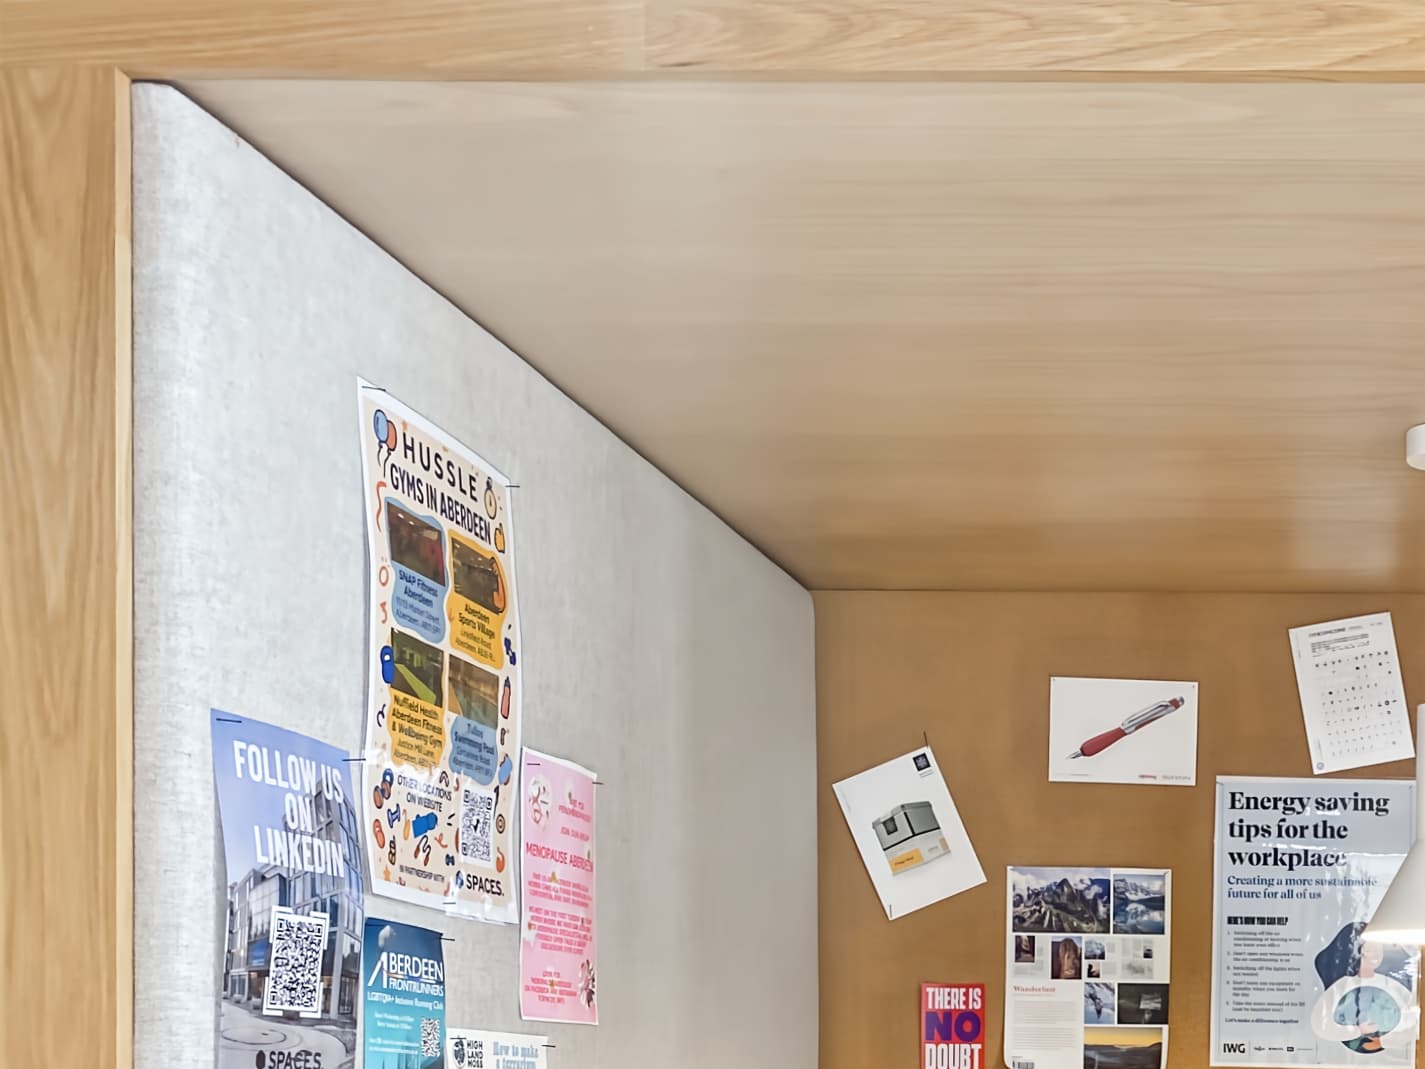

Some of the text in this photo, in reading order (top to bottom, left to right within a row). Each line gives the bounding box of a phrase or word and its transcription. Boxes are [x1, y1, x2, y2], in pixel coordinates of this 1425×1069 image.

[402, 432, 478, 502] HUSSLE
[390, 464, 491, 545] GYMS IN ABERDEEN
[399, 570, 439, 597] SNAP Fitness
[404, 586, 433, 608] Aberdeen
[465, 604, 490, 623] Aberdeen
[458, 613, 476, 629] Sports
[477, 621, 495, 639] Village
[392, 708, 442, 735] Aberdeen Fitness
[233, 740, 344, 803] FOLLOW US
[285, 792, 313, 832] ON
[407, 792, 443, 812] ON WEBSITE
[1228, 792, 1390, 817] Energy saving
[1228, 818, 1348, 842] tips for the
[253, 825, 344, 878] LINKEDIN
[526, 842, 568, 864] MENOPAUSE
[1228, 848, 1347, 871] workplace
[466, 873, 504, 896] SPACES.
[1227, 875, 1274, 887] Creating
[1285, 878, 1313, 886] more
[1227, 889, 1262, 899] future
[1264, 889, 1278, 899] for
[1280, 889, 1293, 899] all
[1296, 889, 1308, 899] of
[368, 952, 443, 988] ABERDEEN
[389, 979, 443, 996] FRONTRUNNERS
[926, 988, 982, 1009] THERE IS
[925, 1011, 981, 1042] NO
[467, 1039, 483, 1050] HIGH
[467, 1051, 483, 1060] LAND
[1223, 1043, 1245, 1053] IWG
[468, 1060, 483, 1069] MOSS
